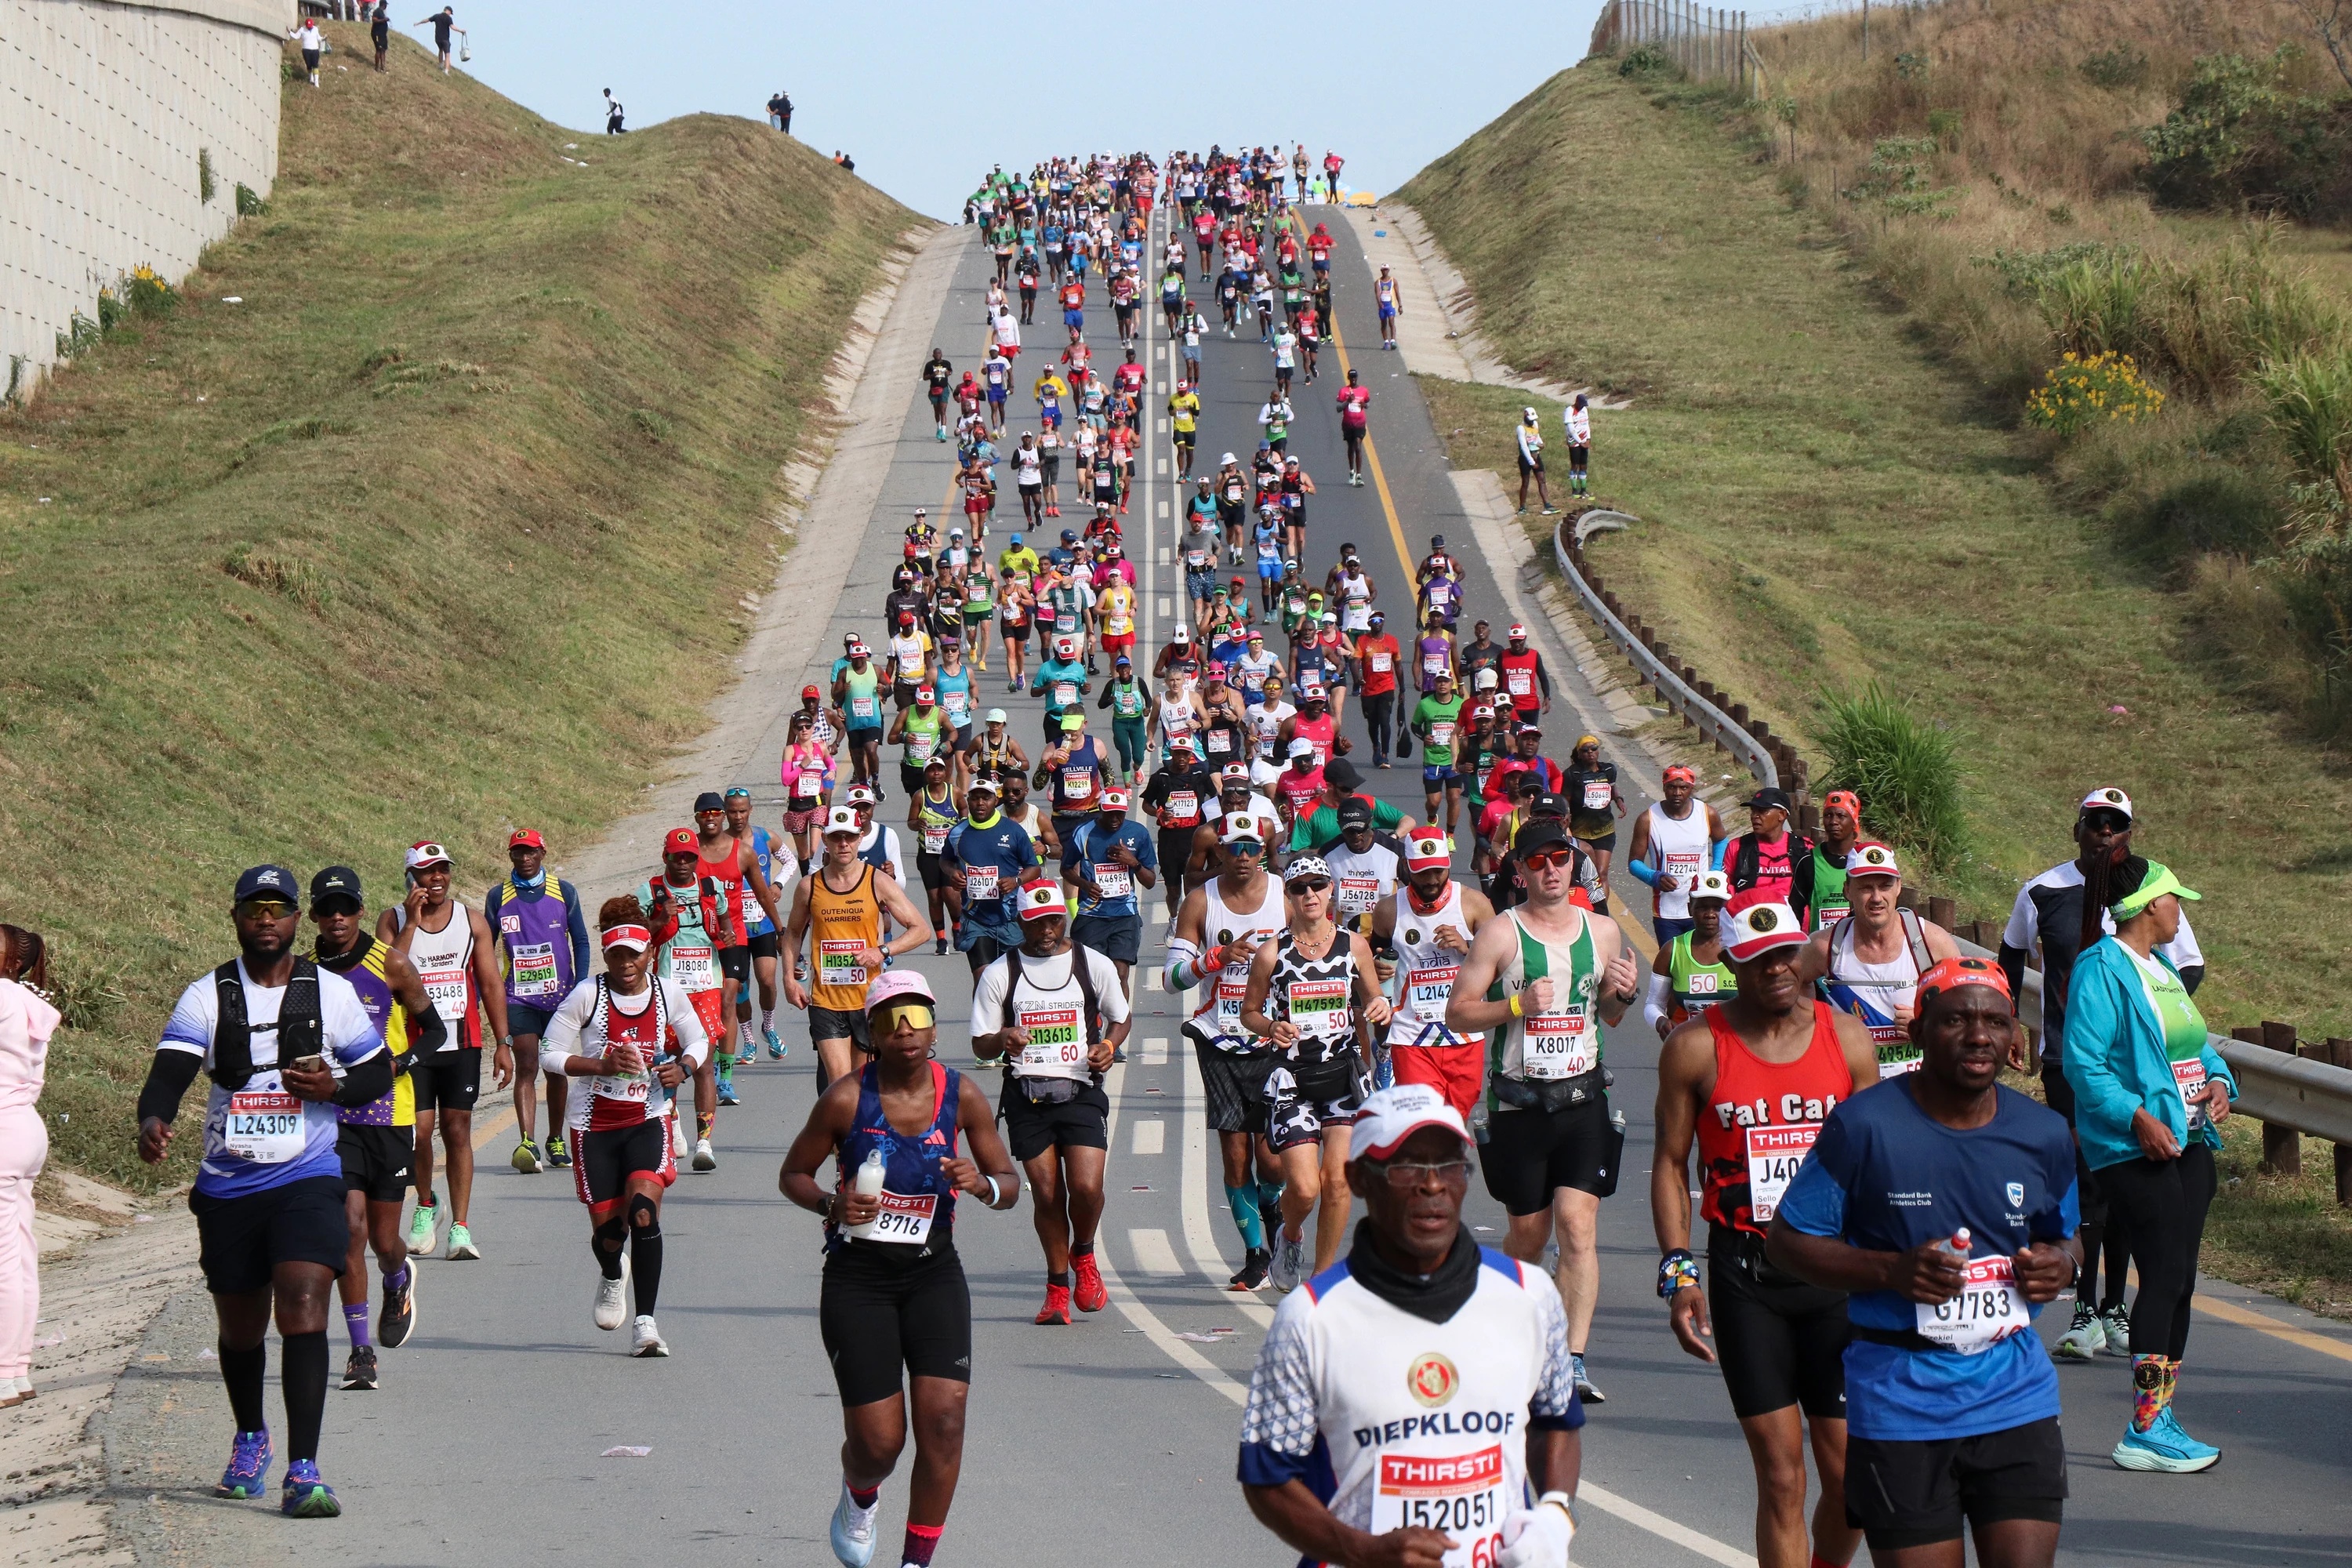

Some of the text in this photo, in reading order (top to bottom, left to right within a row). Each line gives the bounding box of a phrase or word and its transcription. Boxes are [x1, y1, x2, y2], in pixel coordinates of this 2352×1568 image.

[1177, 706, 1187, 717] 60
[1668, 864, 1697, 873] F22744
[1763, 865, 1791, 873] VITAL
[970, 877, 994, 887] J26107
[1098, 873, 1127, 884] K46984
[986, 888, 998, 898] 40
[1119, 884, 1130, 895] 50
[1342, 890, 1375, 900] J56728
[502, 916, 518, 933] 50
[427, 952, 459, 963] HARMONY
[517, 957, 551, 966] THIRSTI
[826, 955, 858, 967] H1352
[1417, 950, 1450, 969] india
[676, 960, 708, 971] J18080
[420, 973, 461, 982] THIRSTI
[520, 967, 552, 982] E29519
[699, 974, 713, 985] 40
[851, 969, 865, 982] 50
[1414, 970, 1457, 980] THIRSTI
[543, 979, 556, 993] 50
[1293, 983, 1341, 993] THIRSTI
[1512, 979, 1529, 991] VA
[1689, 975, 1715, 993] 50
[427, 985, 463, 1000] 53488
[1417, 984, 1452, 1001] L2142
[451, 1000, 466, 1015] 40
[1013, 1000, 1084, 1014] KZN STRIDERS
[1294, 997, 1343, 1013] H47593
[1023, 1013, 1072, 1022] THIRSTI
[1328, 1011, 1346, 1029] 50
[1529, 1020, 1581, 1029] THIRSTI
[1029, 1027, 1072, 1044] H13613
[1536, 1036, 1576, 1054] K8017
[1061, 1044, 1079, 1062] 60
[1877, 1046, 1920, 1061] 49540
[1566, 1056, 1585, 1074] 40
[2175, 1063, 2204, 1076] THIRS
[627, 1083, 647, 1098] 60
[233, 1097, 296, 1106] THIRSTI
[1715, 1093, 1836, 1129] Fat Cat
[234, 1115, 297, 1134] L24309
[1755, 1132, 1817, 1146] THIRS
[1759, 1158, 1800, 1183] J40
[880, 1195, 926, 1208] IRSTI
[1757, 1194, 1777, 1203] Sello
[878, 1213, 921, 1236] 8716
[1961, 1264, 2009, 1281] RSTI
[1934, 1289, 2010, 1322] G7783
[1353, 1411, 1514, 1448] DIEPKLOOF
[1388, 1453, 1495, 1482] THIRSTI
[1392, 1490, 1494, 1531] J52051
